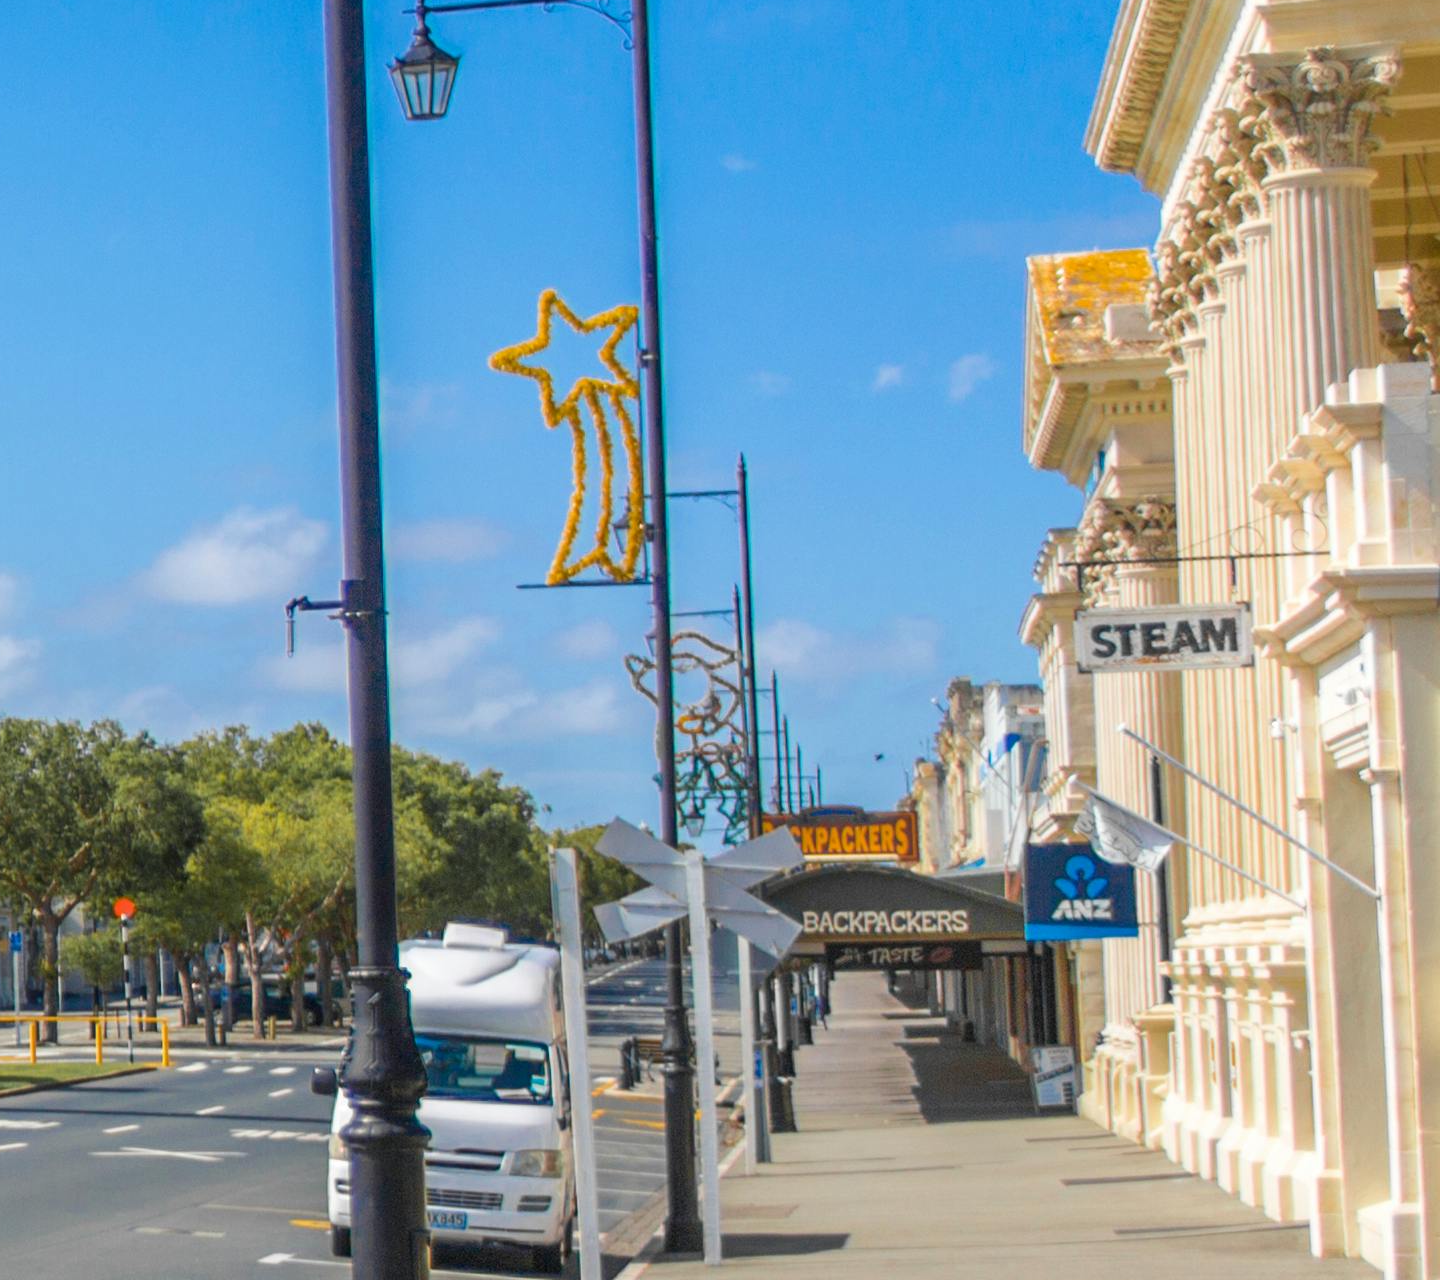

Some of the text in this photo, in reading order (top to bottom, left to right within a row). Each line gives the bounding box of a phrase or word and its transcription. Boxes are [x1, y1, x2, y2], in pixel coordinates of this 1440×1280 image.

[1090, 616, 1239, 658] STEAM
[763, 818, 909, 855] KPACKERS
[802, 909, 969, 933] BACKPACKERS
[1051, 898, 1112, 920] ANZ
[867, 946, 924, 964] TASTE
